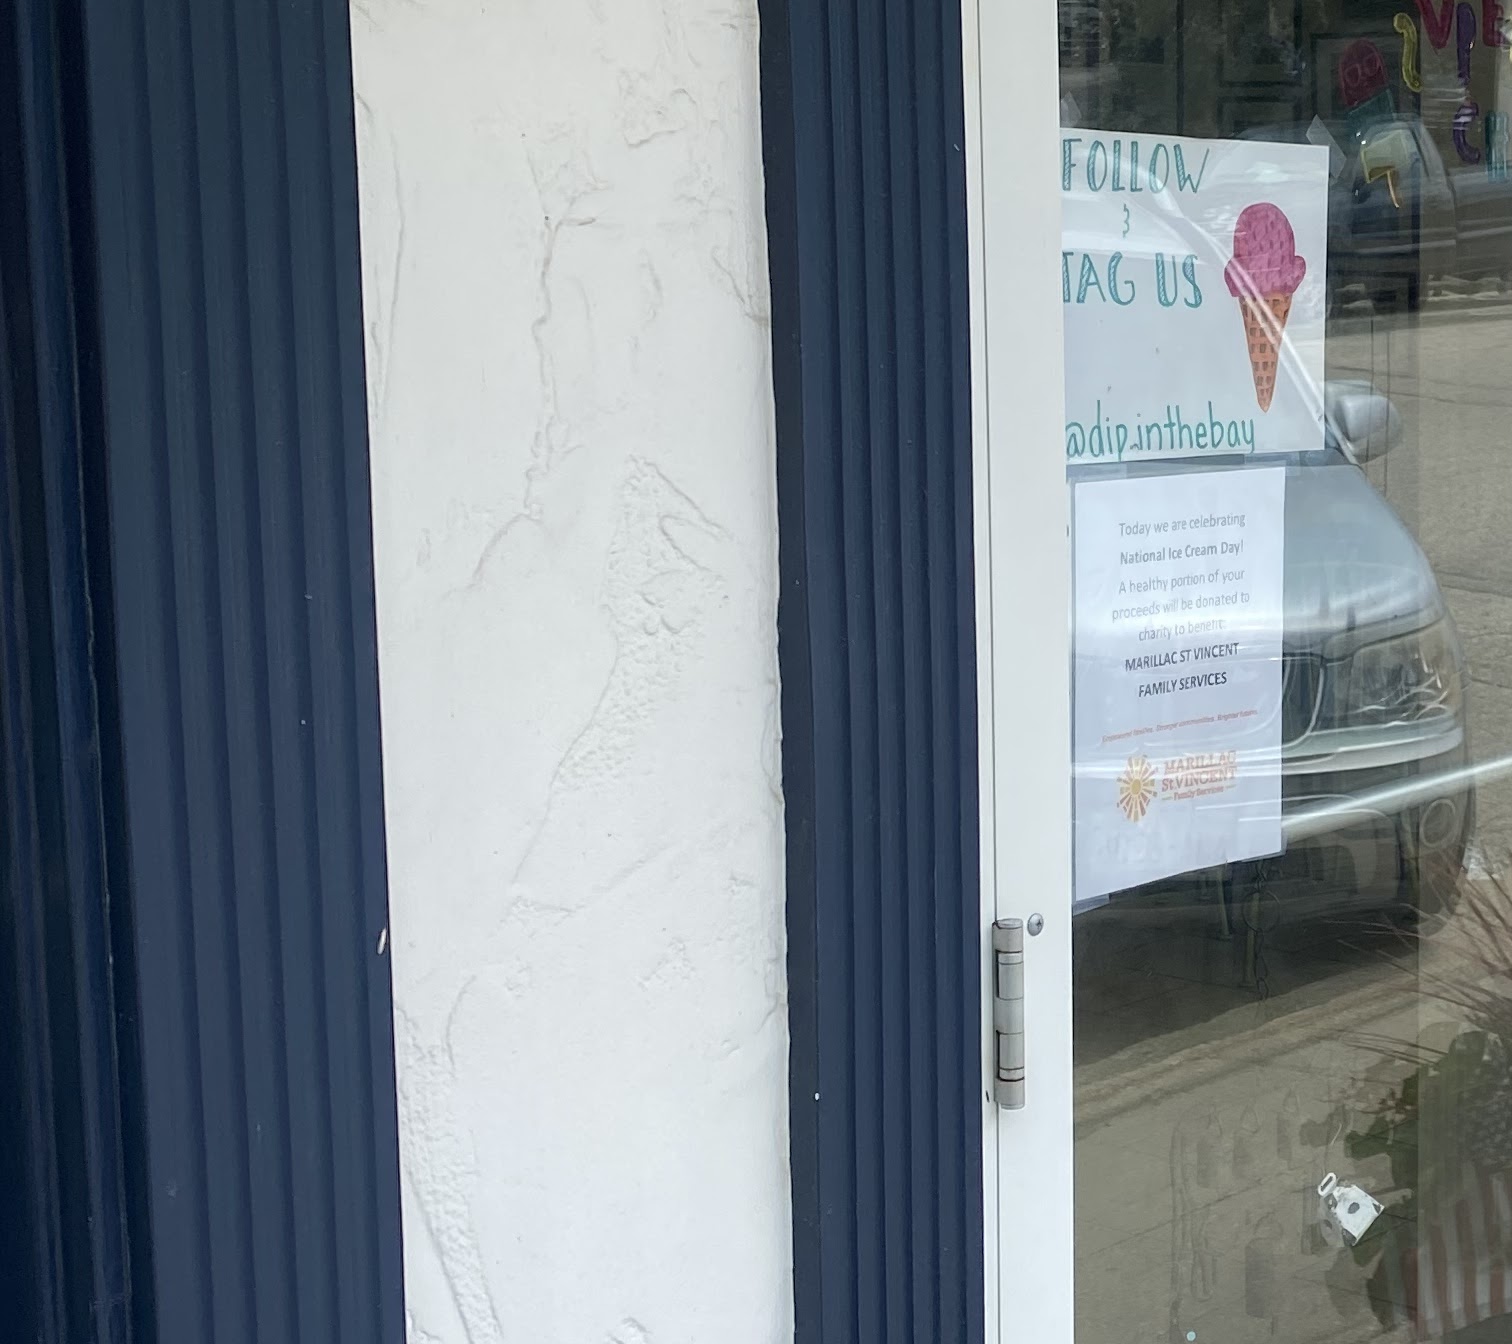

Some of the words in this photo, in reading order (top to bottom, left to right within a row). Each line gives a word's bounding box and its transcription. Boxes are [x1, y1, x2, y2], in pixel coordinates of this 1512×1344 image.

[1061, 137, 1211, 194] FOLLOW
[1061, 251, 1136, 306] TAG
[1153, 252, 1203, 309] US
[1119, 521, 1152, 537] Today
[1154, 521, 1169, 533] we
[1172, 519, 1188, 532] are
[1190, 513, 1246, 529] celebrating
[1120, 547, 1166, 565] National
[1169, 547, 1183, 561] Ice
[1185, 544, 1218, 559] Cream
[1221, 539, 1244, 557] Day!
[1119, 580, 1127, 595] A
[1129, 576, 1169, 593] healthy
[1171, 574, 1206, 591] portion
[1208, 569, 1220, 583] of
[1222, 569, 1246, 585] your
[1112, 601, 1161, 624] proceeds
[1163, 598, 1179, 614] will
[1181, 598, 1194, 611] be
[1196, 592, 1238, 609] donated
[1241, 592, 1251, 604] to
[1138, 626, 1172, 642] charity
[1175, 623, 1186, 637] to
[1125, 651, 1178, 673] MARILLAC
[1180, 649, 1193, 663] ST
[1194, 643, 1240, 661] VINCENT
[1139, 680, 1179, 698] FAMILY
[1179, 672, 1228, 692] SERVICES
